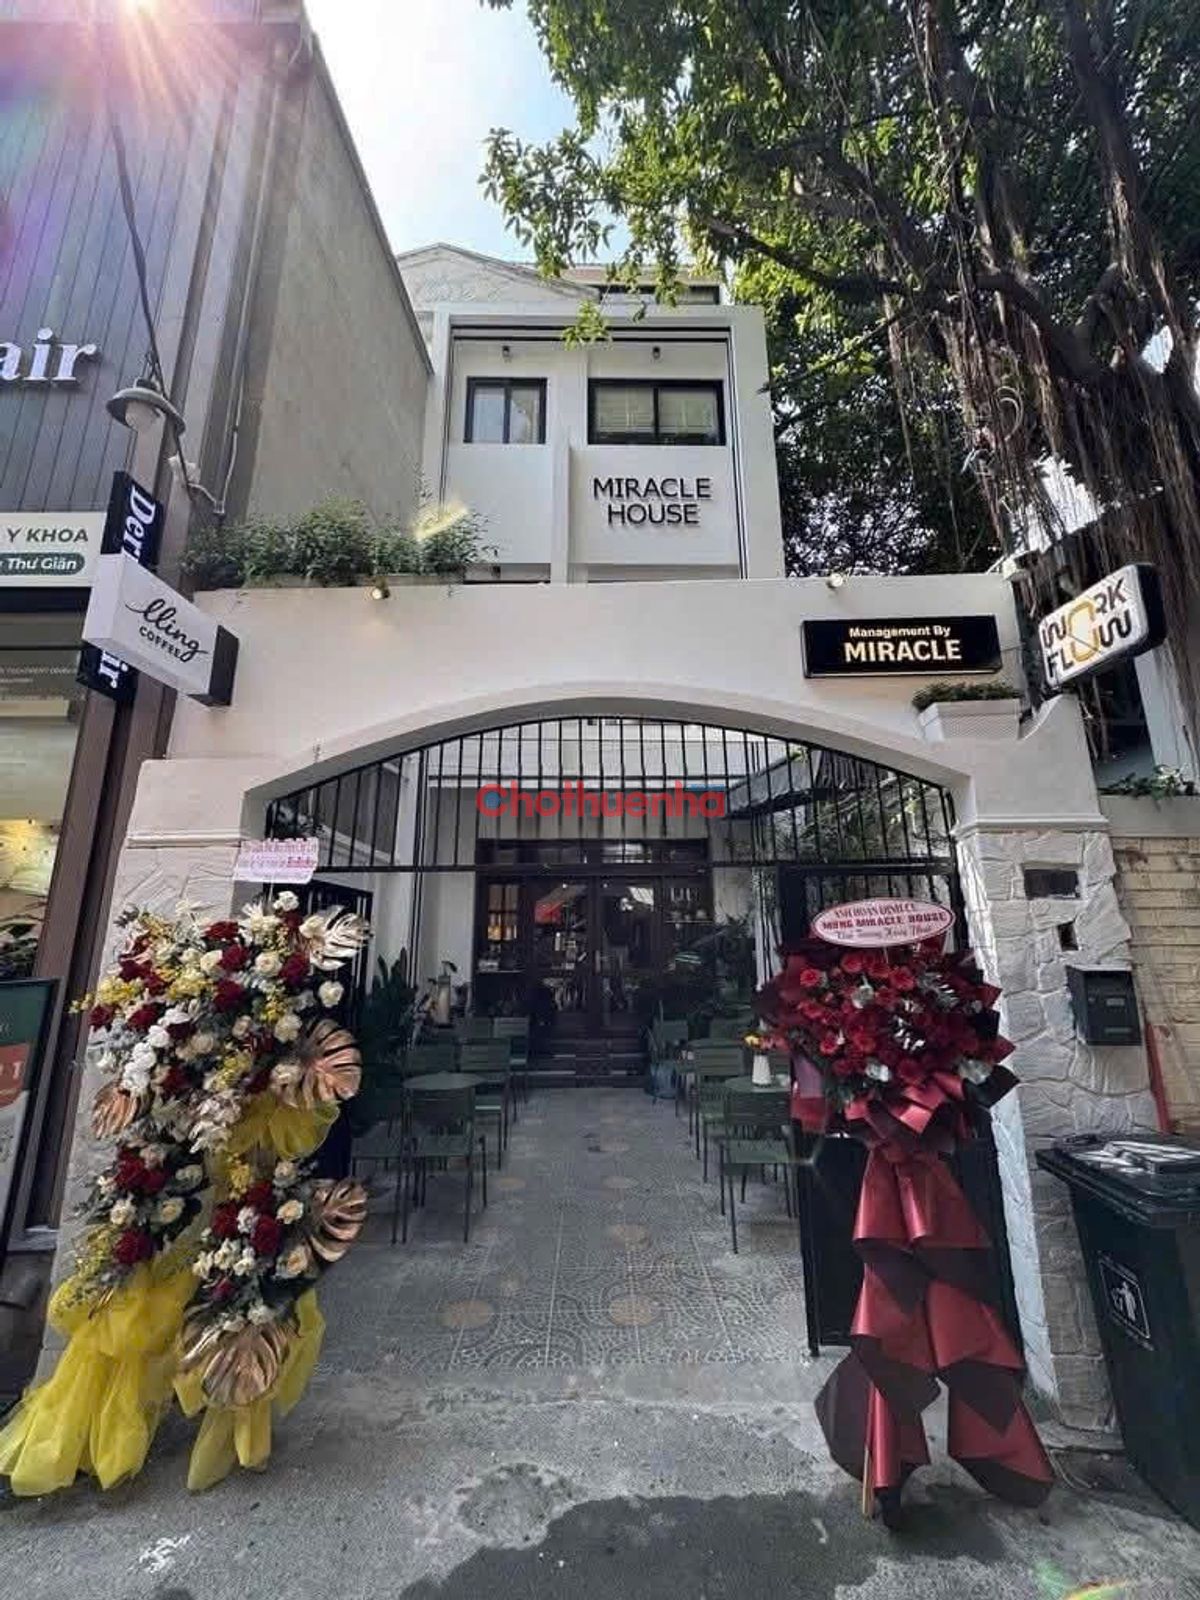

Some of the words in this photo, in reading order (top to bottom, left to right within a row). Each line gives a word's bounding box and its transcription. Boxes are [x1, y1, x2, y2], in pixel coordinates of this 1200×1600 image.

[593, 477, 712, 498] MIRACLE
[607, 503, 700, 525] HOUSE
[7, 528, 22, 542] Y
[26, 528, 89, 542] KHOA
[8, 557, 38, 569] Thư
[1042, 576, 1127, 648] WORK
[139, 625, 182, 659] COFFEE
[849, 626, 931, 639] Management
[932, 625, 951, 637] By
[844, 639, 962, 663] MIRACLE
